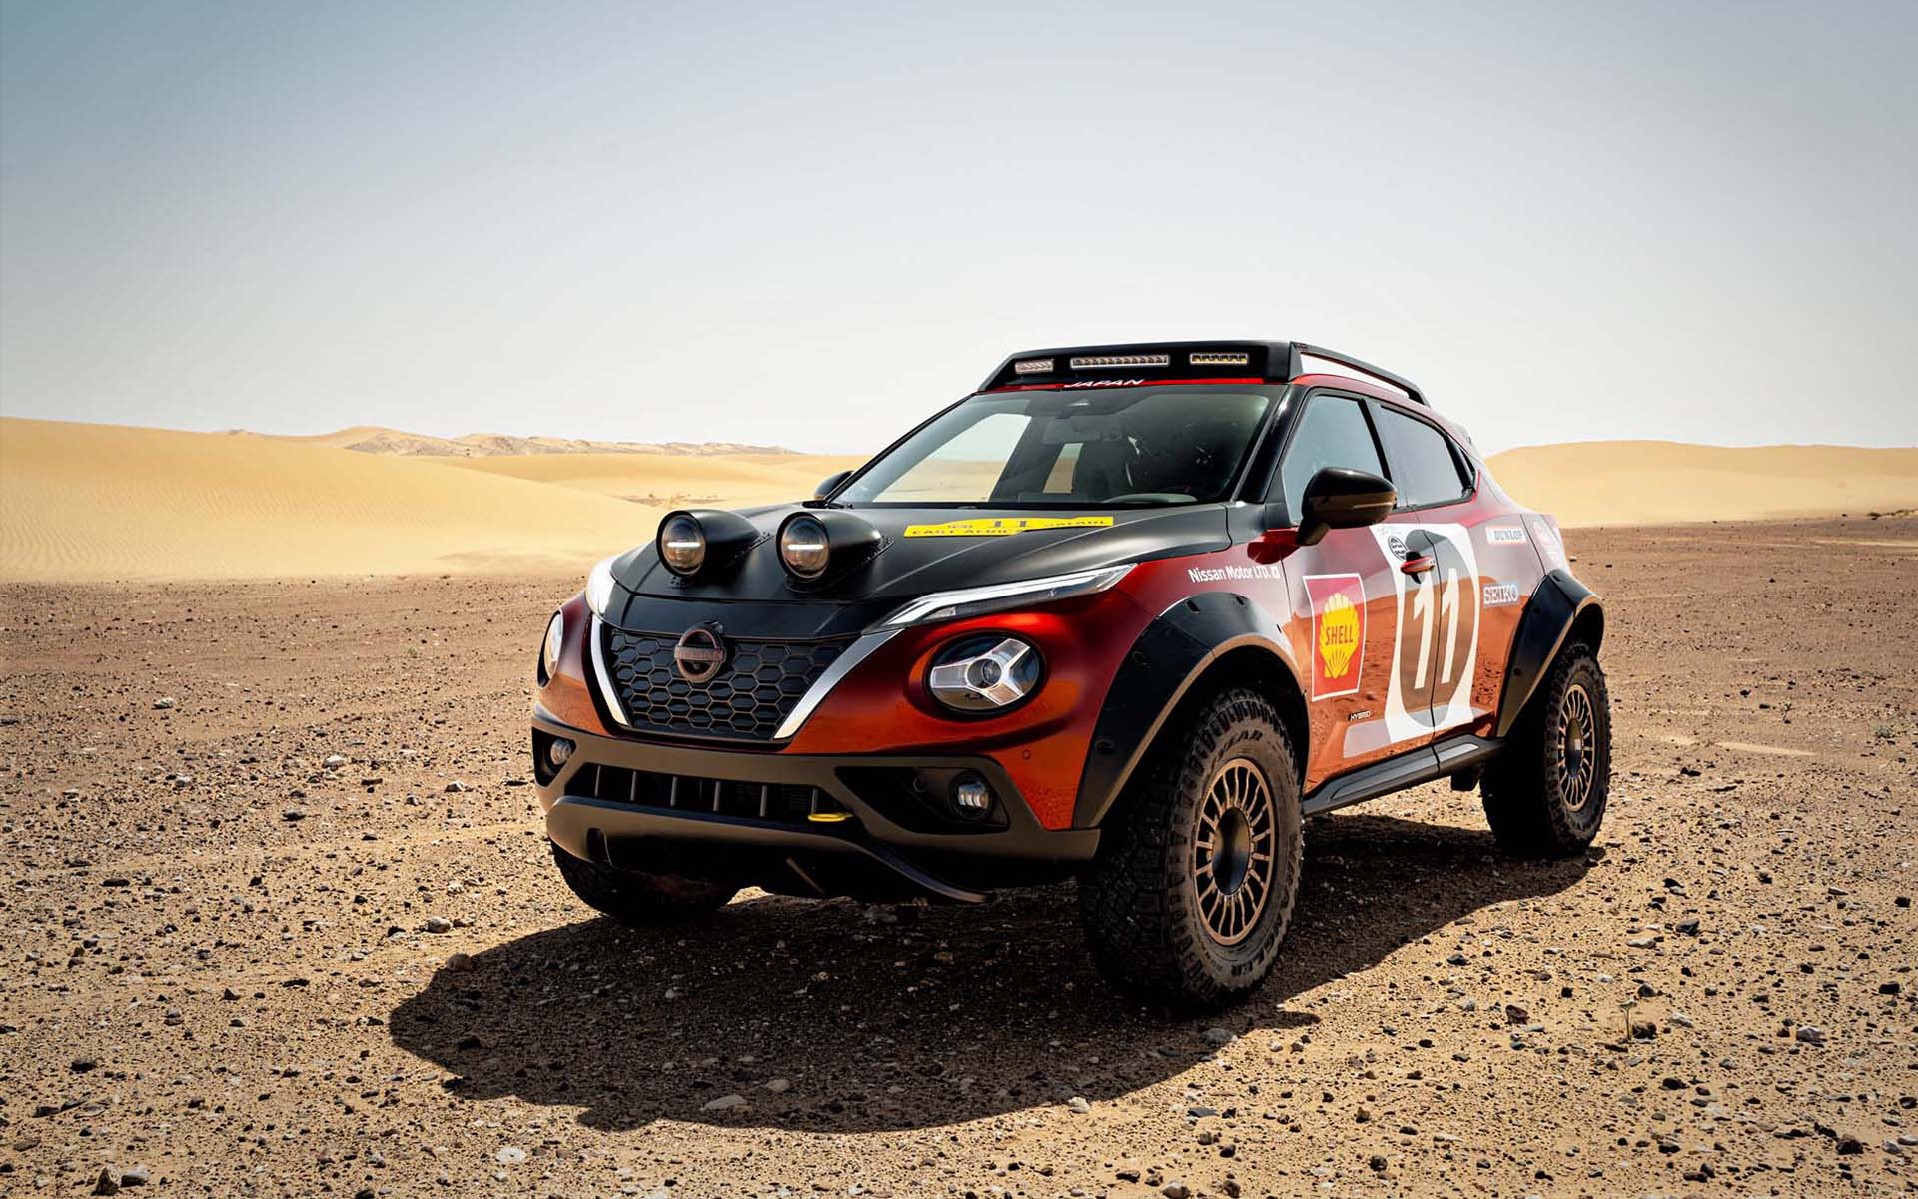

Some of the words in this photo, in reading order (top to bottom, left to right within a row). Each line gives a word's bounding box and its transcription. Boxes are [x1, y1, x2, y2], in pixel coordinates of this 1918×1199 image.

[1063, 379, 1145, 388] JAPAN
[1493, 529, 1523, 541] DUNLOP
[1187, 567, 1227, 583] Nissan
[1225, 565, 1254, 580] Motor
[1483, 583, 1519, 605] SEIKO
[1325, 624, 1354, 646] SHELL
[1413, 567, 1460, 690] 11
